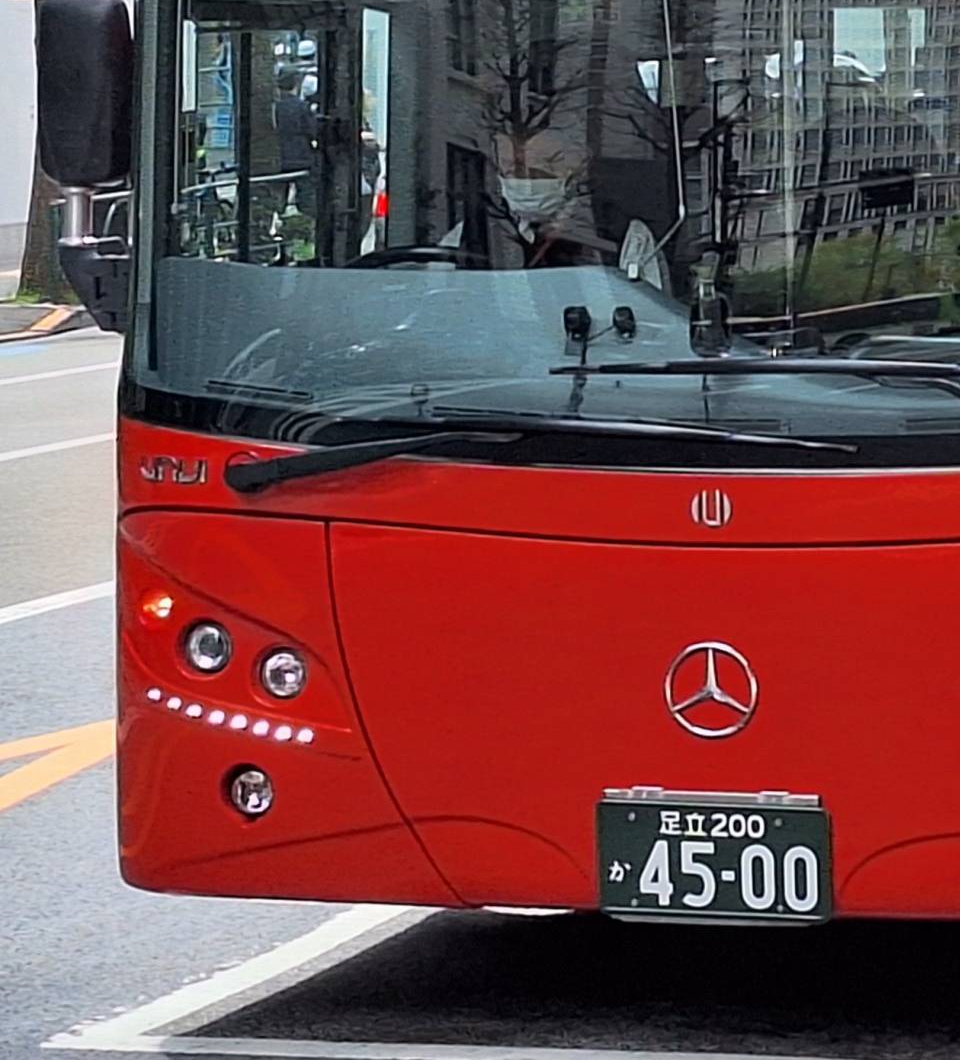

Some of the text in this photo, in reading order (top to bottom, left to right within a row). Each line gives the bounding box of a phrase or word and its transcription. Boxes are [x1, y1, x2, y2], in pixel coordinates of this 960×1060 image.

[608, 809, 819, 913] 足立200 か 45-00
